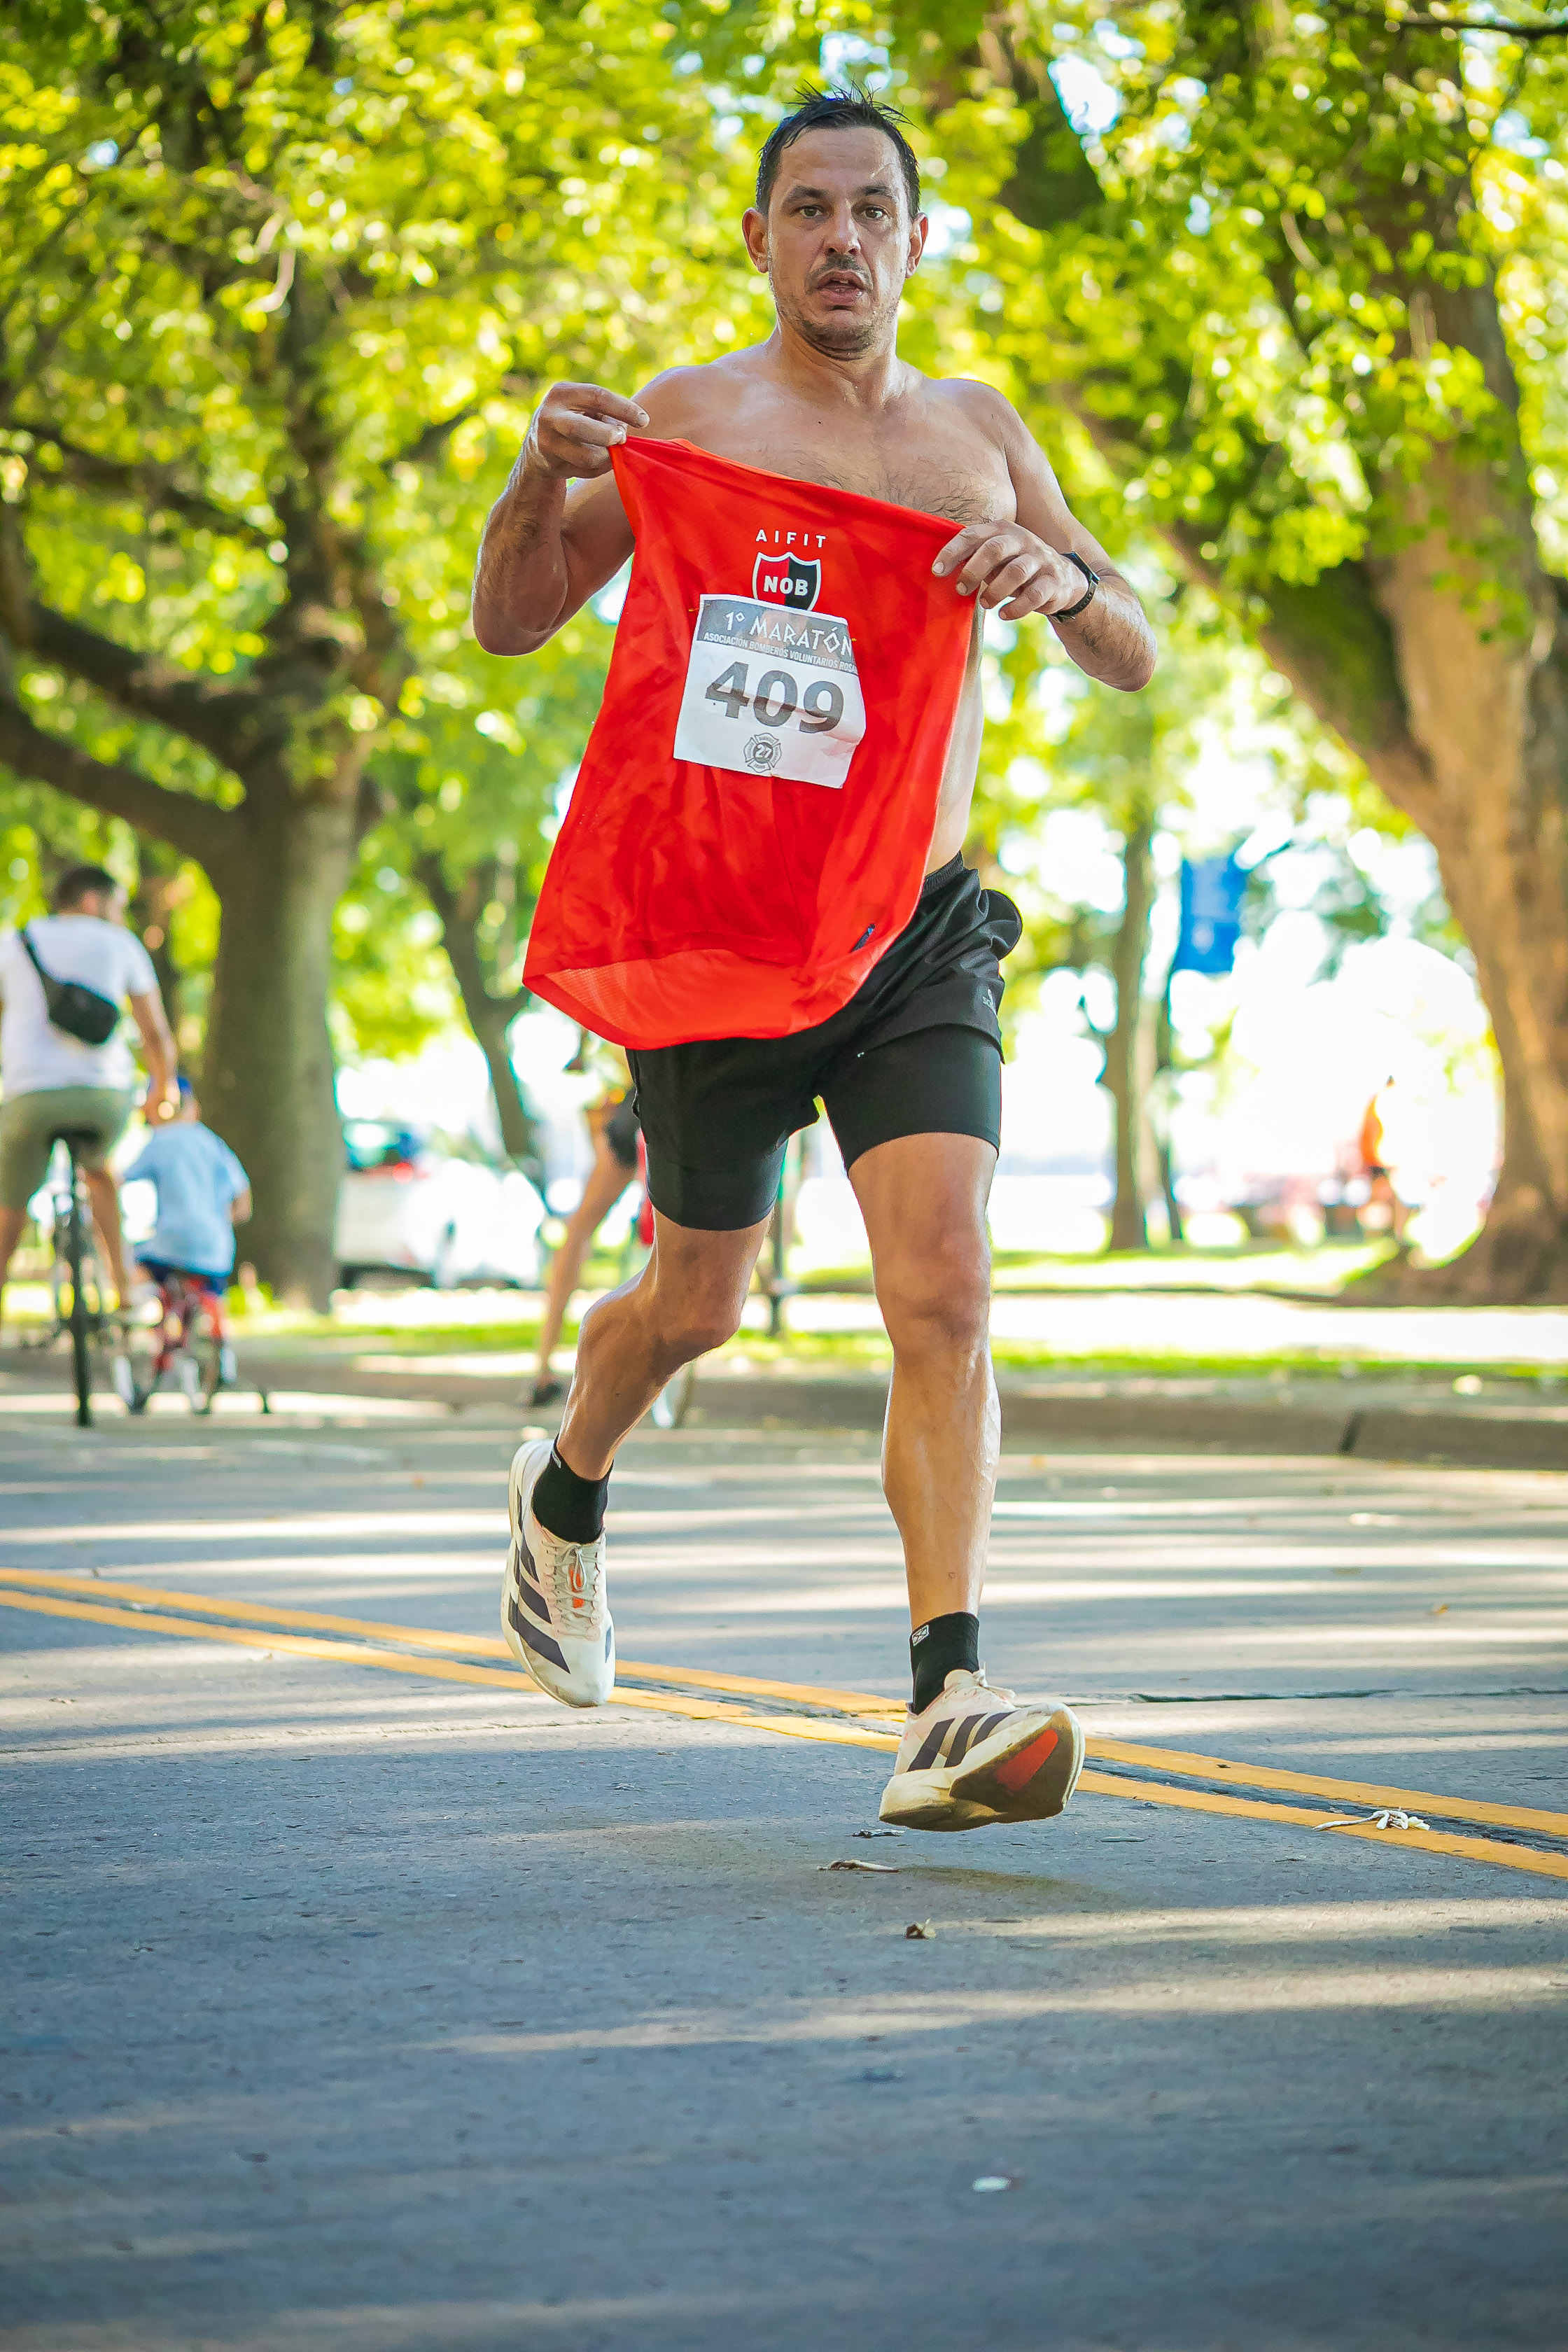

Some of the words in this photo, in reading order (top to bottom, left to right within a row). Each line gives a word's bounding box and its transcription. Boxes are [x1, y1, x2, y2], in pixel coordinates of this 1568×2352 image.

[756, 529, 826, 548] AIFIT
[763, 575, 808, 596] NOB
[749, 616, 852, 657] MARATÓN
[749, 641, 788, 657] BOMBEROS
[790, 650, 839, 668] VOLUNTARIOS
[705, 662, 844, 734] 409
[755, 743, 772, 759] 27
